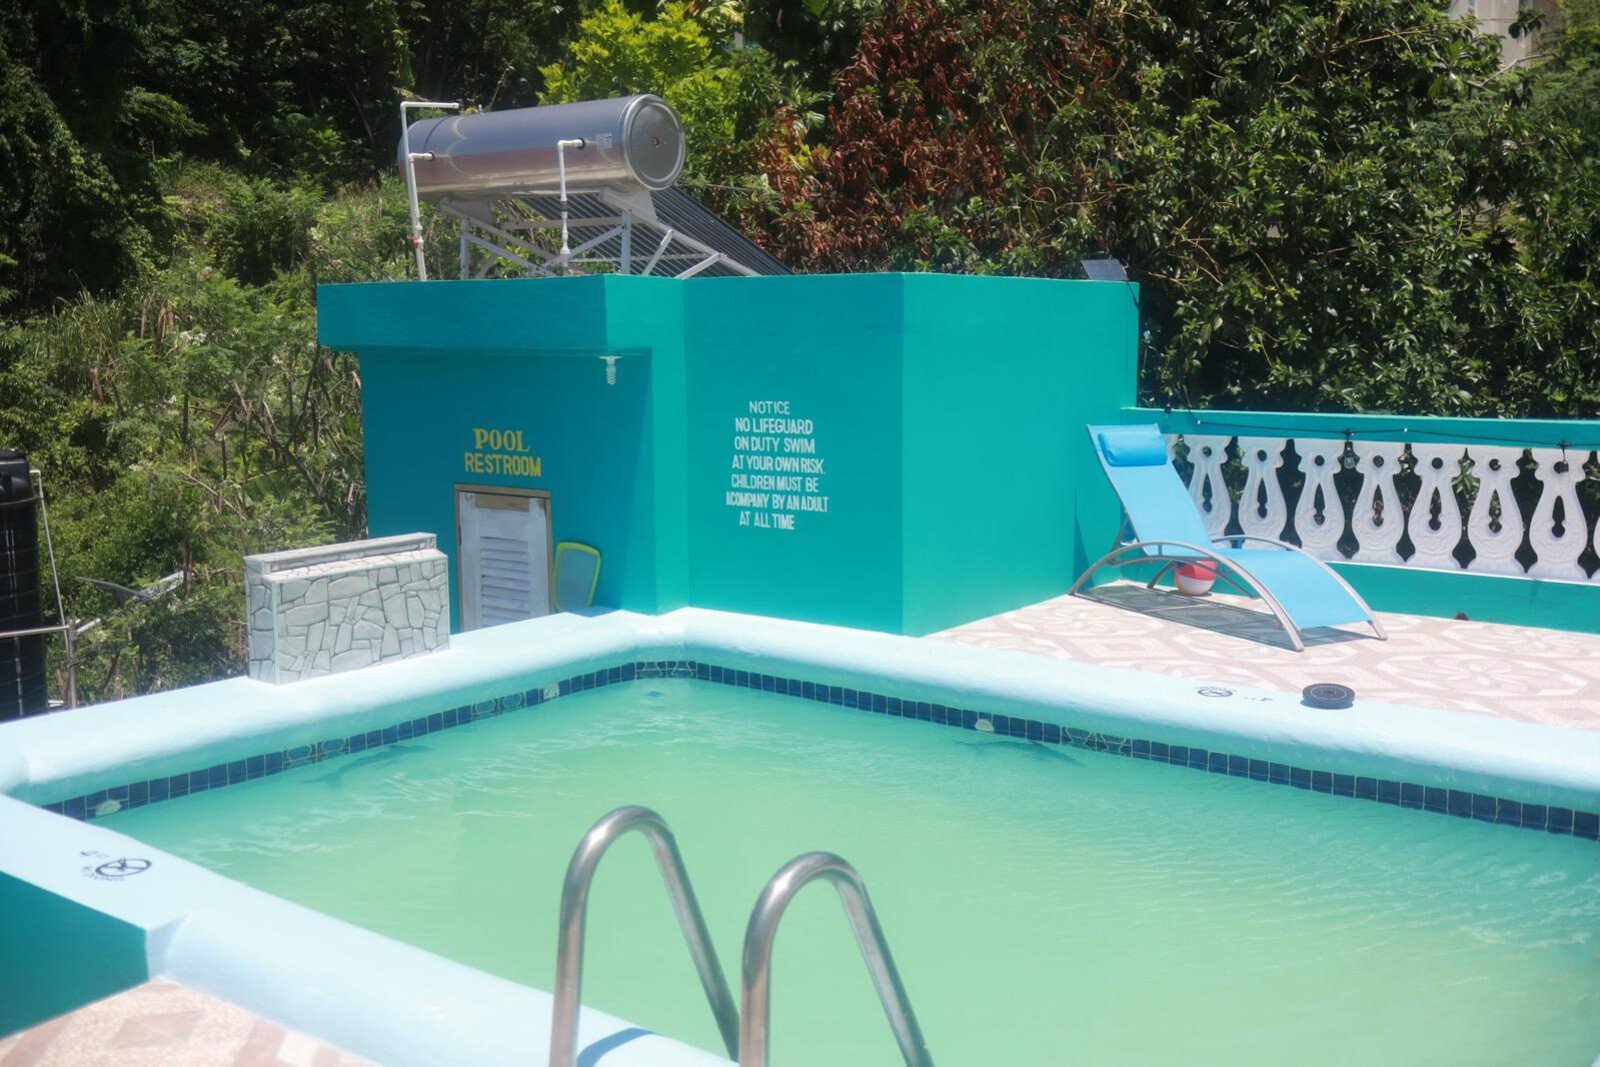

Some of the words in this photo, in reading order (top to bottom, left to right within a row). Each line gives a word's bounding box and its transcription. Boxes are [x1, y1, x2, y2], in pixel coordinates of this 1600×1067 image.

[749, 400, 790, 415] NOTICE
[735, 417, 750, 432] NO
[752, 418, 814, 435] LIFEGUARD
[472, 428, 531, 452] POOL
[734, 435, 749, 451] ON
[751, 436, 780, 453] DUTY
[783, 437, 816, 454] SWIM
[464, 452, 541, 477] RESTROOM
[731, 454, 744, 469] AT
[746, 455, 773, 471] YOUR
[775, 456, 799, 473] OWN
[731, 473, 775, 490] CHILDREN
[776, 475, 802, 492] MUST
[805, 477, 819, 493] BE
[725, 491, 770, 508] ACOMPANY
[772, 493, 786, 509] BY
[786, 495, 799, 511] AN
[801, 496, 829, 512] ADULT
[739, 511, 751, 526] AT
[754, 512, 771, 528] ALL
[771, 513, 795, 530] TIME
